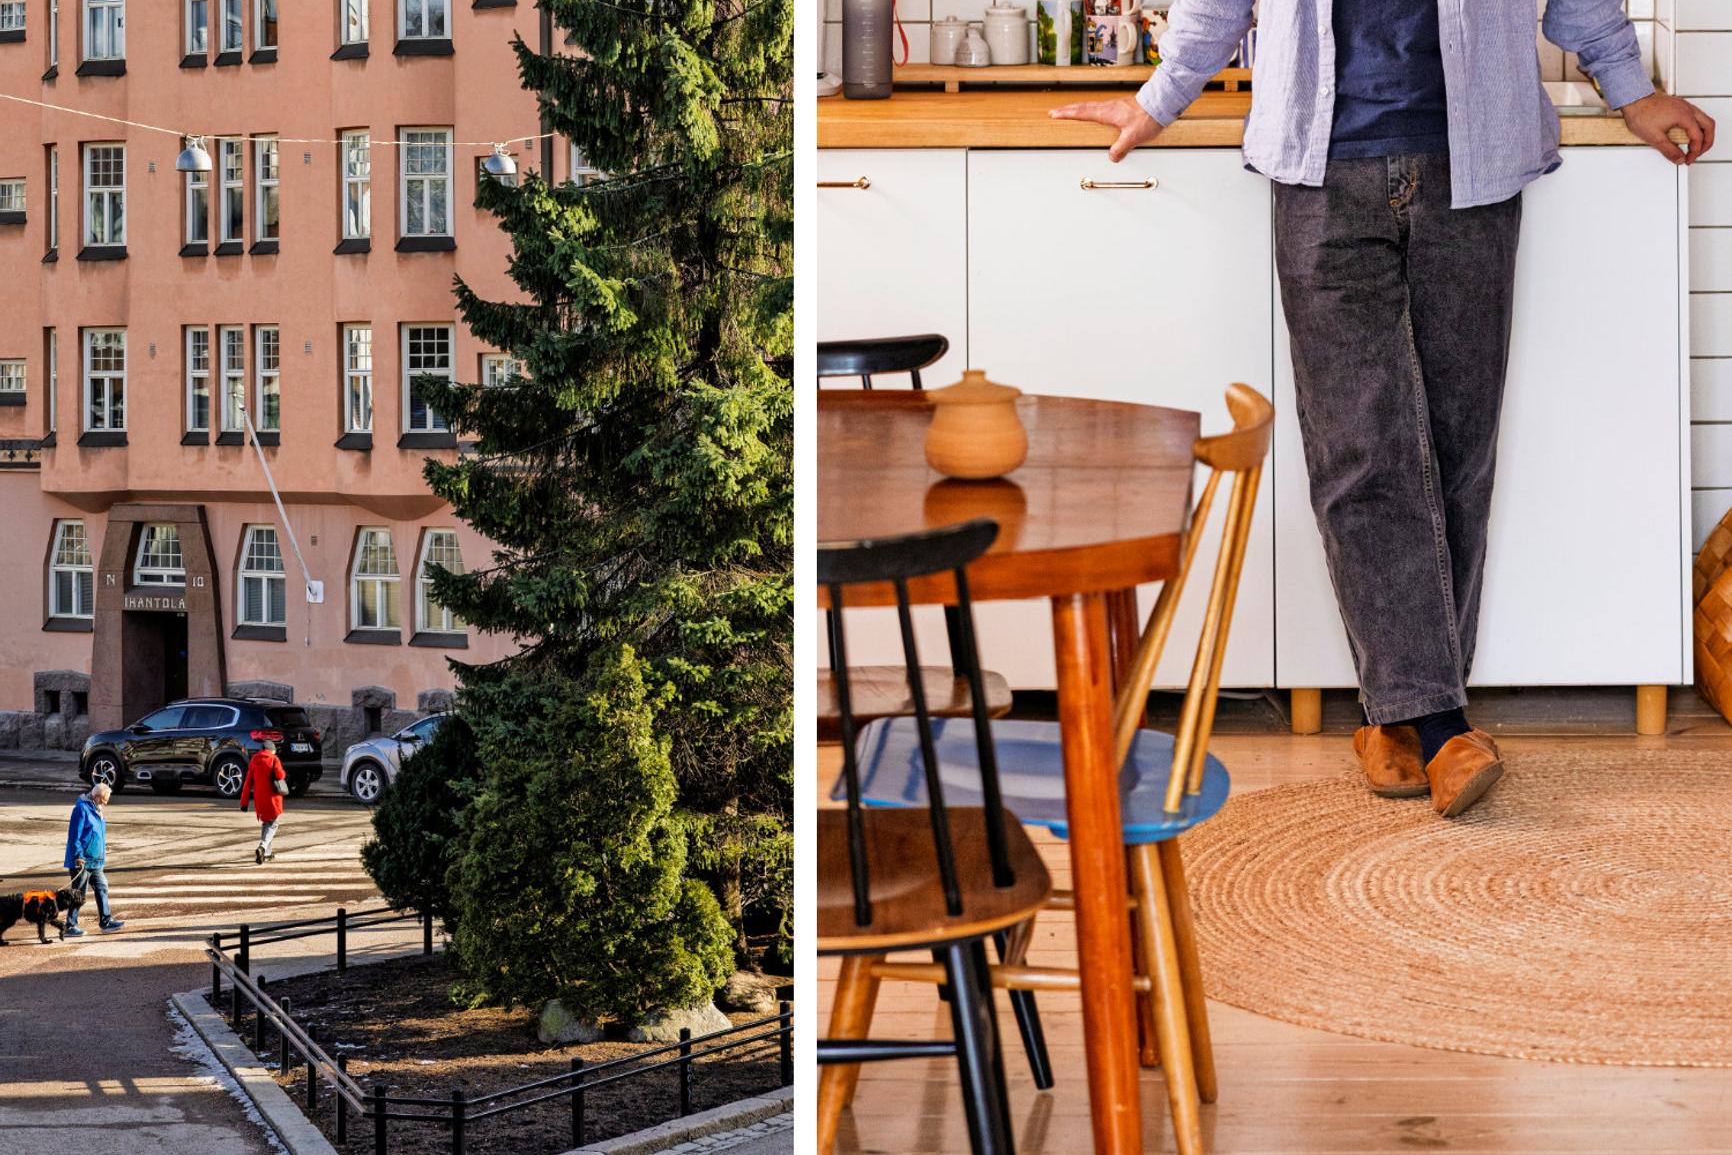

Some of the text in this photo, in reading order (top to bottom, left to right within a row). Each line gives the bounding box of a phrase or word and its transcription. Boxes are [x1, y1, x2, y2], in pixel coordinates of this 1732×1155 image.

[106, 574, 204, 587] N 10
[124, 597, 185, 609] IHANTOLA
